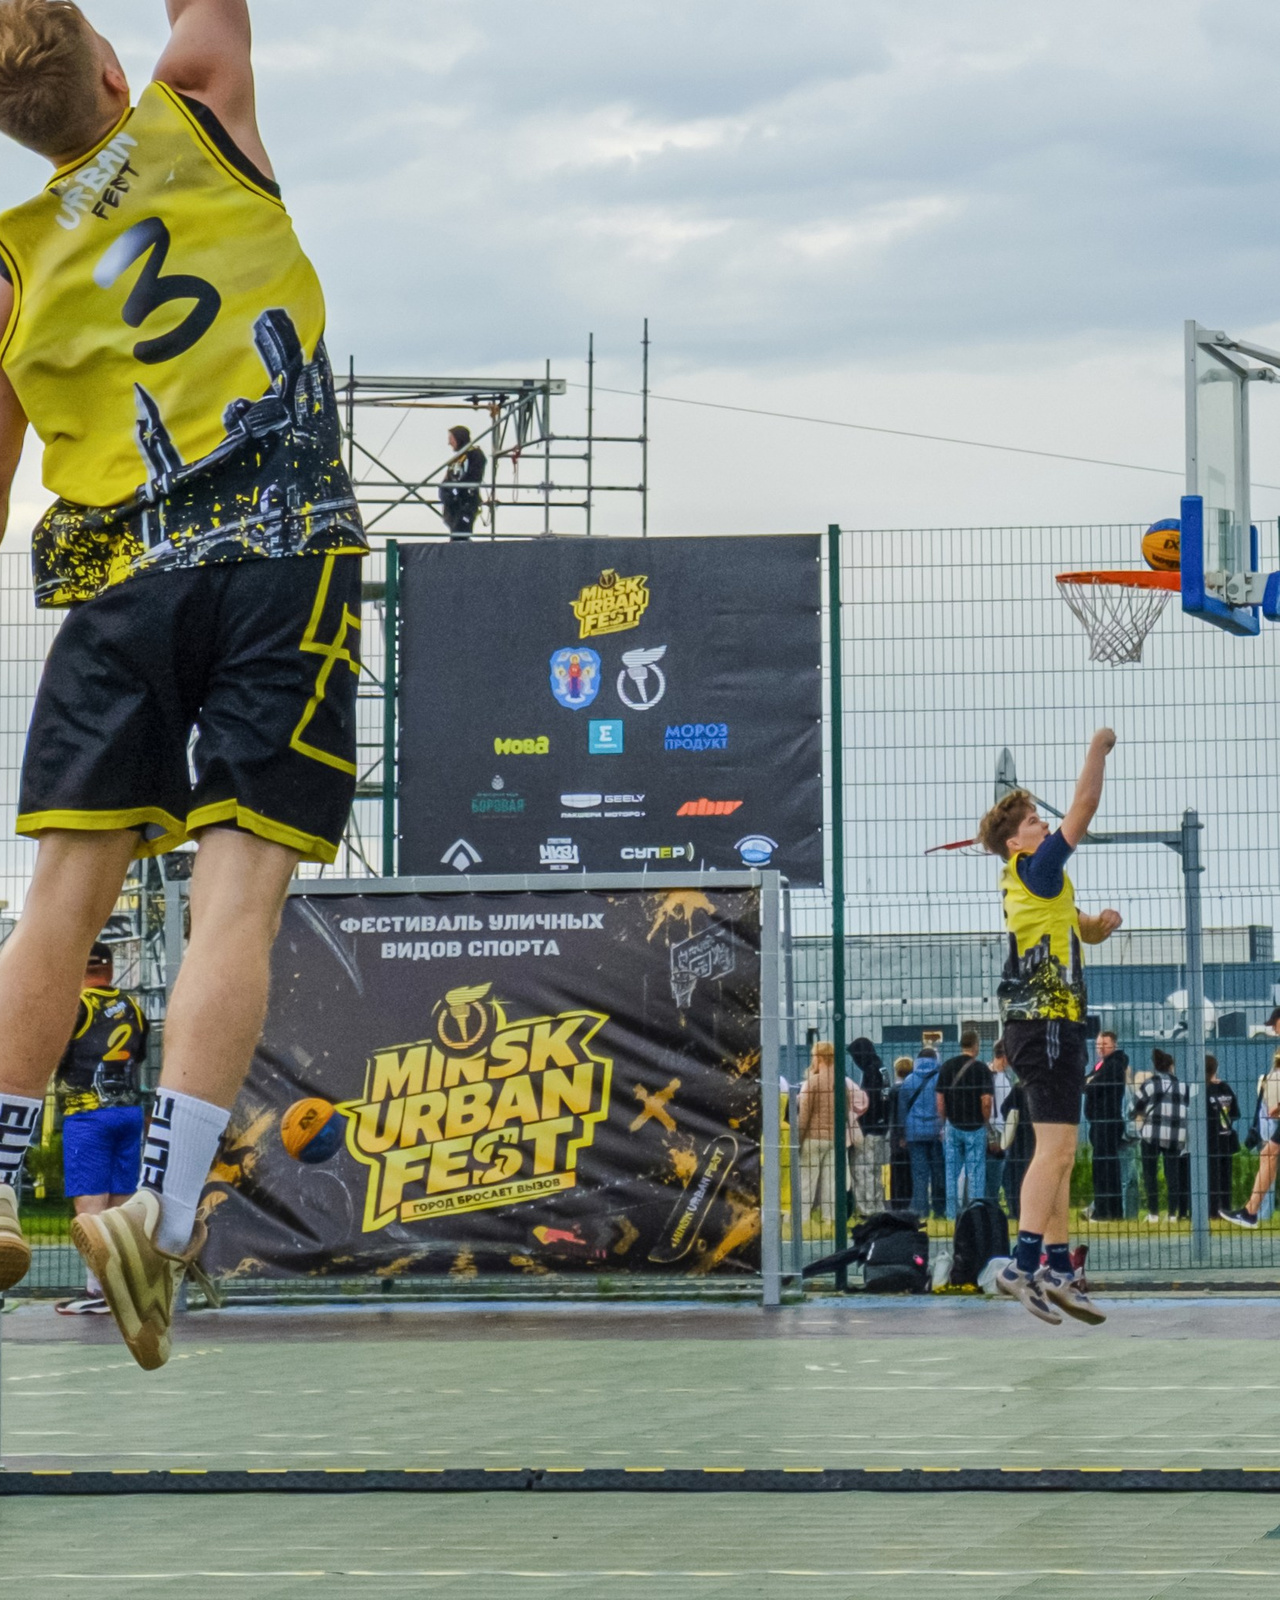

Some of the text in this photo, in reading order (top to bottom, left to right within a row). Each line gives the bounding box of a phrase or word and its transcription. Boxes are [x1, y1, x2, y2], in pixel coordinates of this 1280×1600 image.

[55, 132, 138, 230] URBAN
[92, 216, 222, 365] 3
[581, 578, 641, 602] MINSK
[577, 591, 644, 617] URBAN
[584, 605, 639, 633] FEST
[664, 737, 728, 751] ПРОДУКТ
[665, 723, 728, 738] МОРОЗ
[604, 794, 645, 803] GEELY
[620, 847, 686, 860] СУПЕР
[339, 913, 605, 934] ФЕСТИВАЛЬ УЛИЧНЫХ
[381, 939, 561, 961] ВИДОВ СПОРТА
[102, 1023, 132, 1062] 2
[371, 1017, 586, 1103] MINSK
[352, 1062, 594, 1154] URBAN
[377, 1116, 574, 1216] FEST
[412, 1177, 561, 1214] ГОРОД БРОСАЕТ ВЫЗОВ
